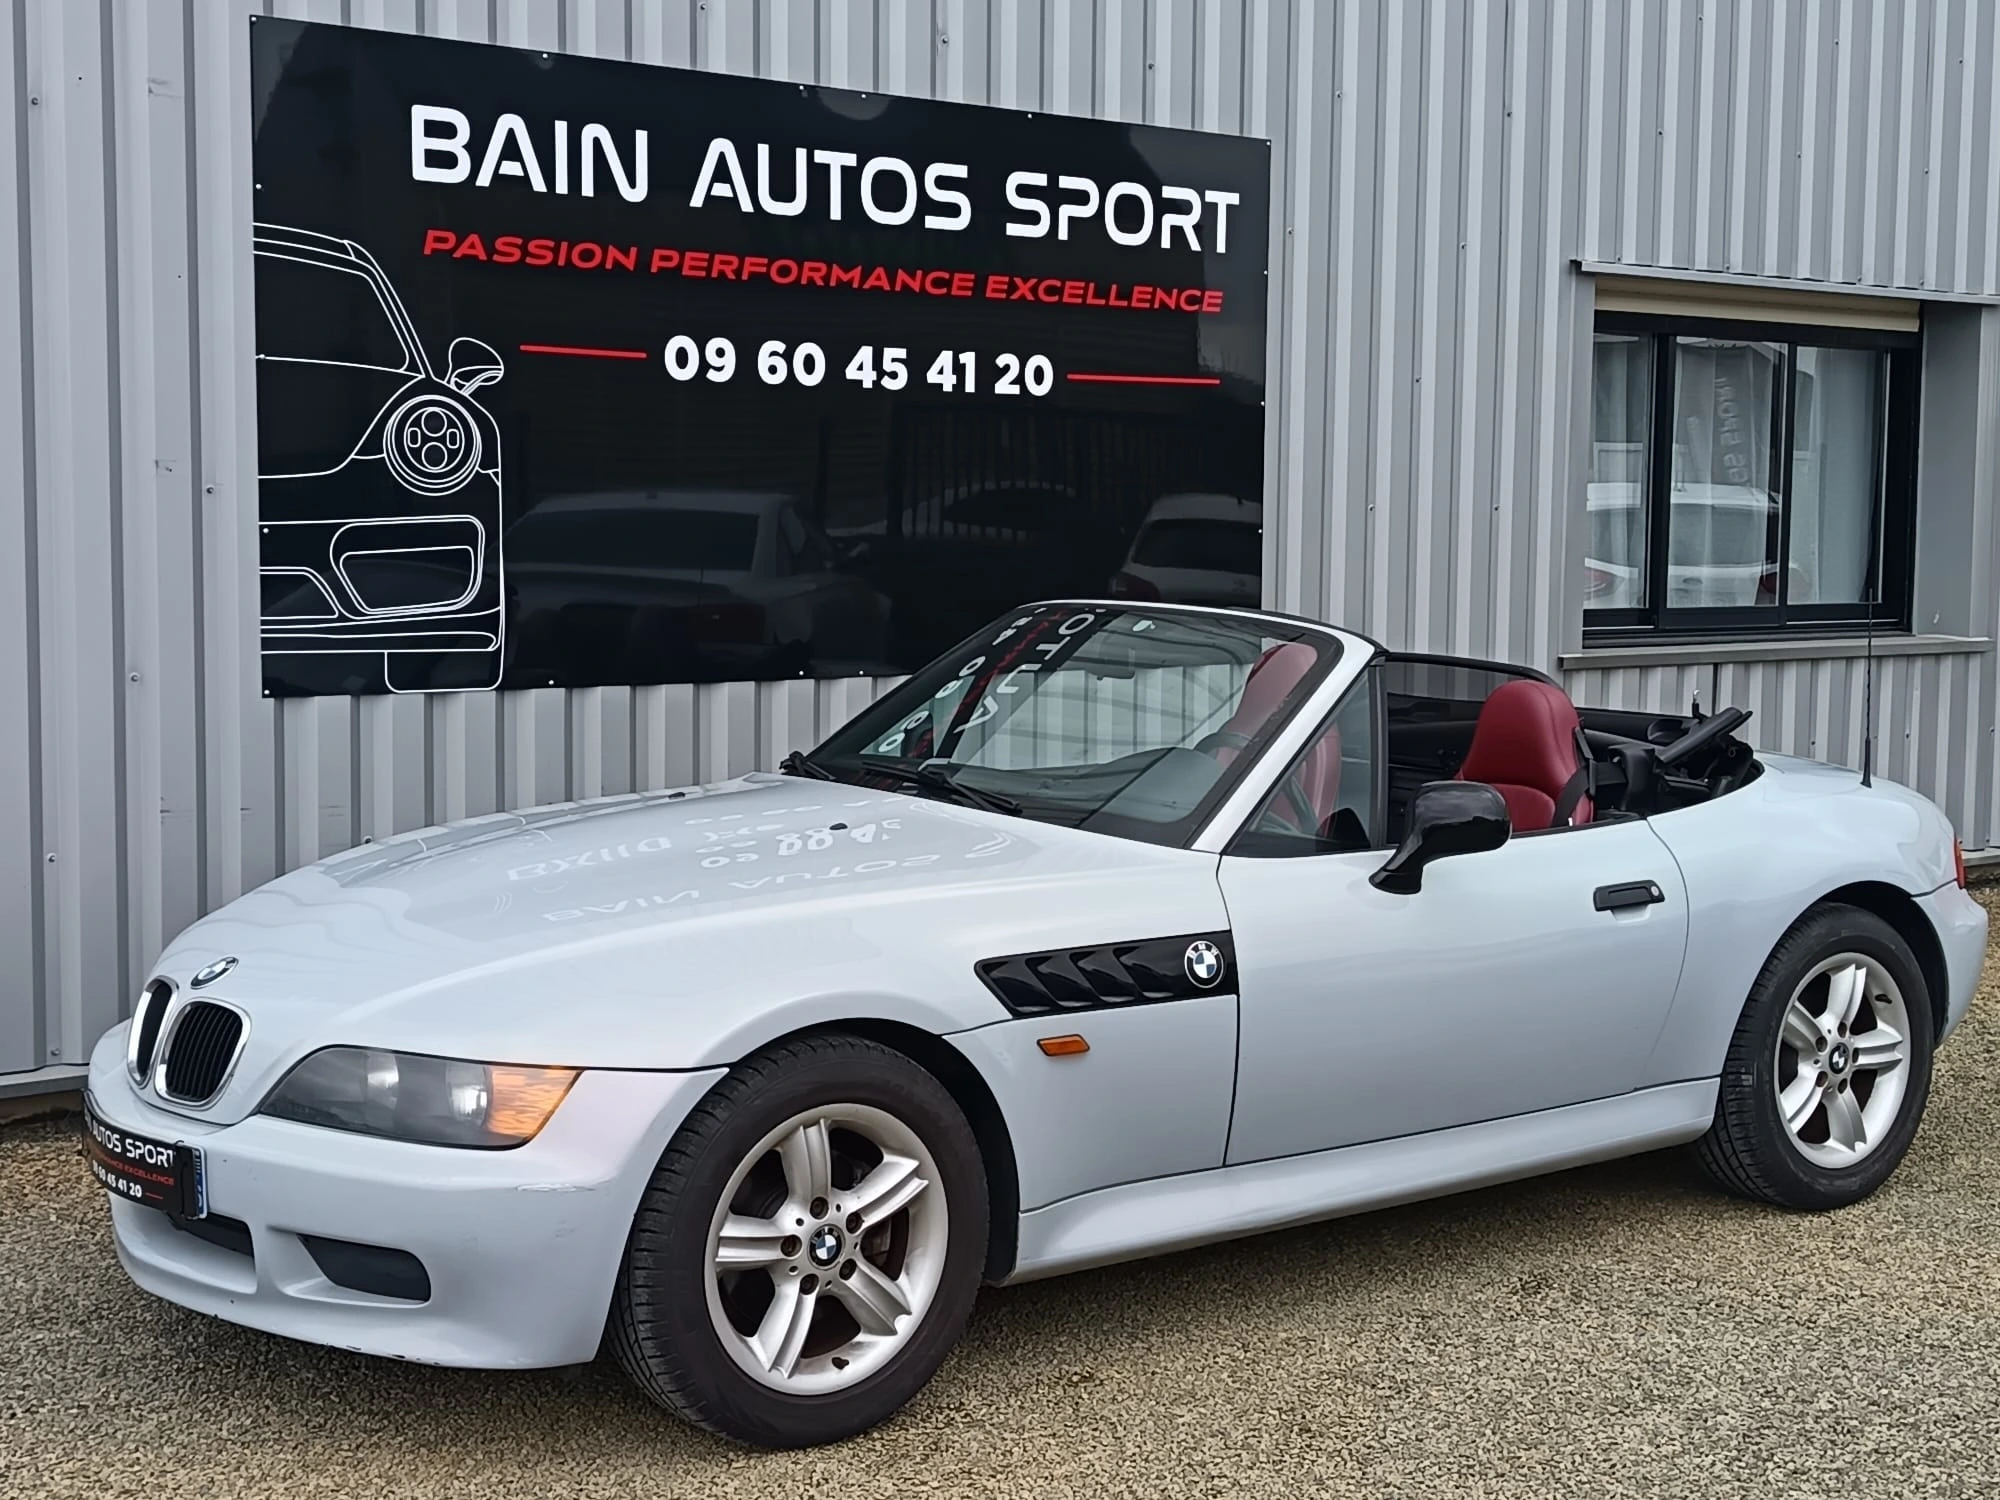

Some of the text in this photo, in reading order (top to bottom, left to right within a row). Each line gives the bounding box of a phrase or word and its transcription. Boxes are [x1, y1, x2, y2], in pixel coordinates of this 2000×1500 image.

[411, 104, 1240, 254] BAIN AUTOS SPORT
[424, 230, 1222, 314] PASSION PERFORMANCE EXCELLENCE
[664, 334, 1054, 397] 09 60 45 41 20
[125, 1138, 174, 1168] SPORT
[118, 1178, 128, 1193] 41
[129, 1182, 143, 1198] 20
